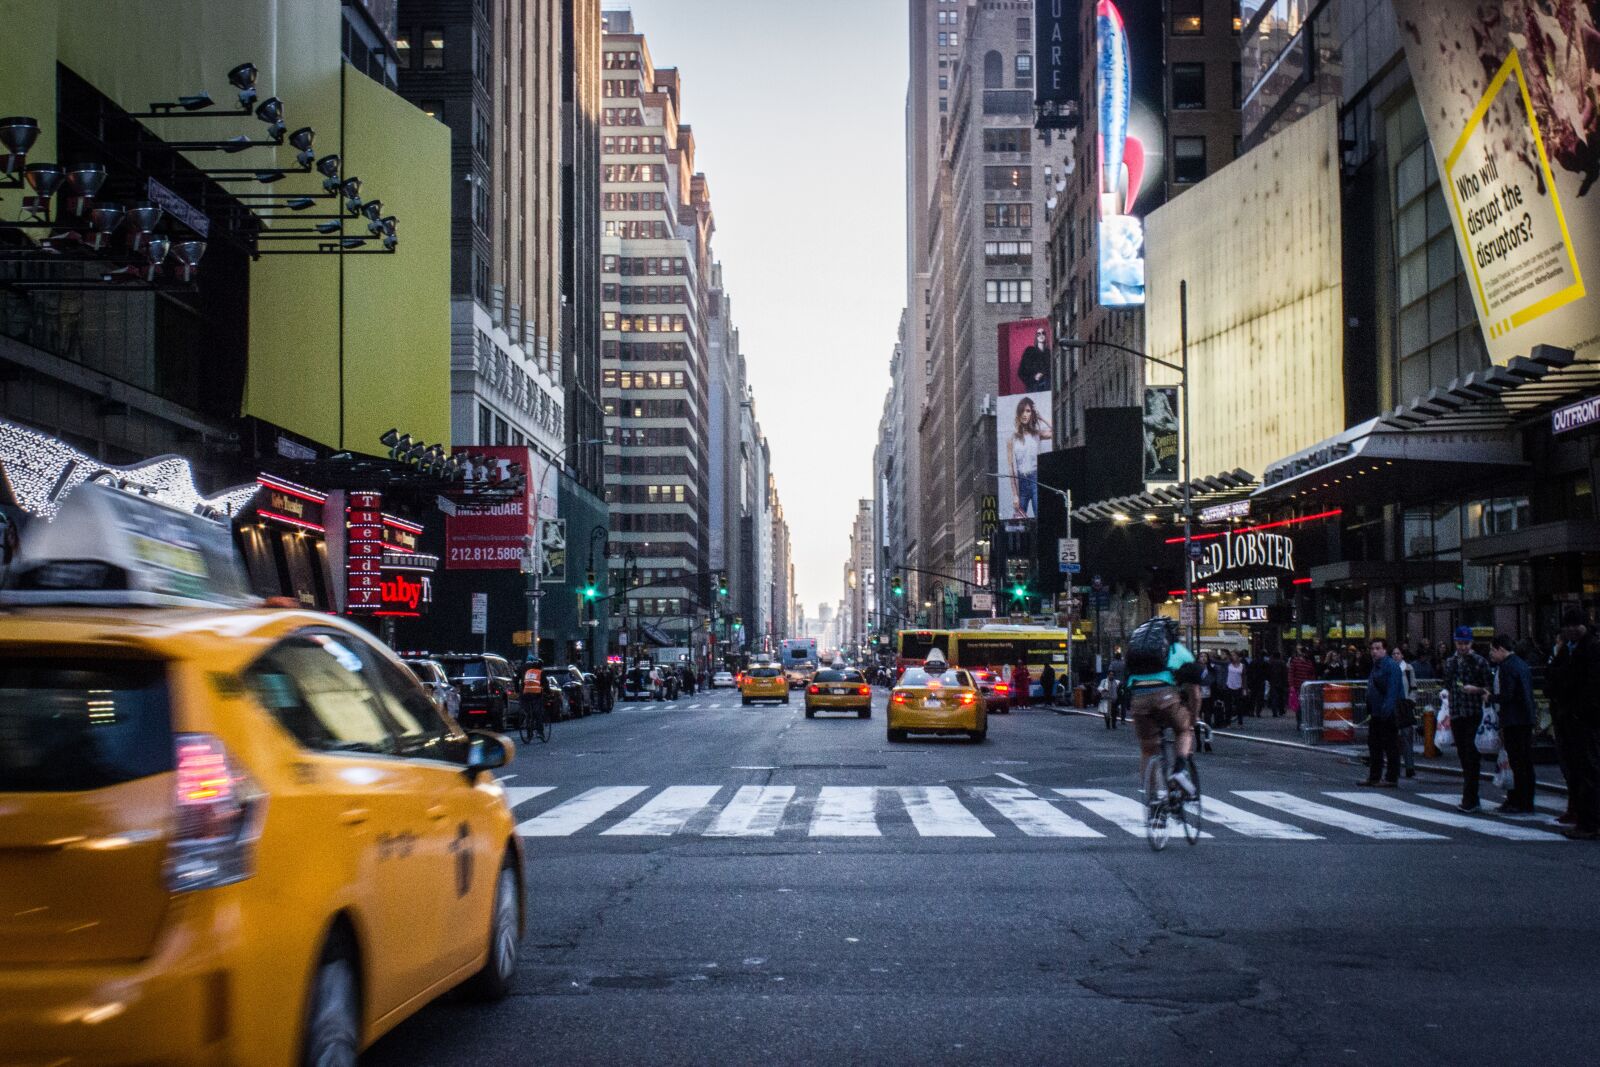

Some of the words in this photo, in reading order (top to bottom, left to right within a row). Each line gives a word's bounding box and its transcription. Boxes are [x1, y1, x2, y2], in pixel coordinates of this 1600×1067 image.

[1456, 173, 1479, 202] Who
[1479, 153, 1499, 187] will
[1467, 193, 1502, 236] disrupt
[1501, 184, 1523, 212] the
[1476, 212, 1534, 268] disruptors?
[362, 495, 373, 603] Tuesday
[452, 547, 525, 561] 212.812.5808
[1061, 551, 1077, 561] 25
[1226, 531, 1295, 571] LOBSTER
[380, 575, 420, 609] uby
[1254, 576, 1278, 590] LOBSTER
[1224, 609, 1241, 620] FISH
